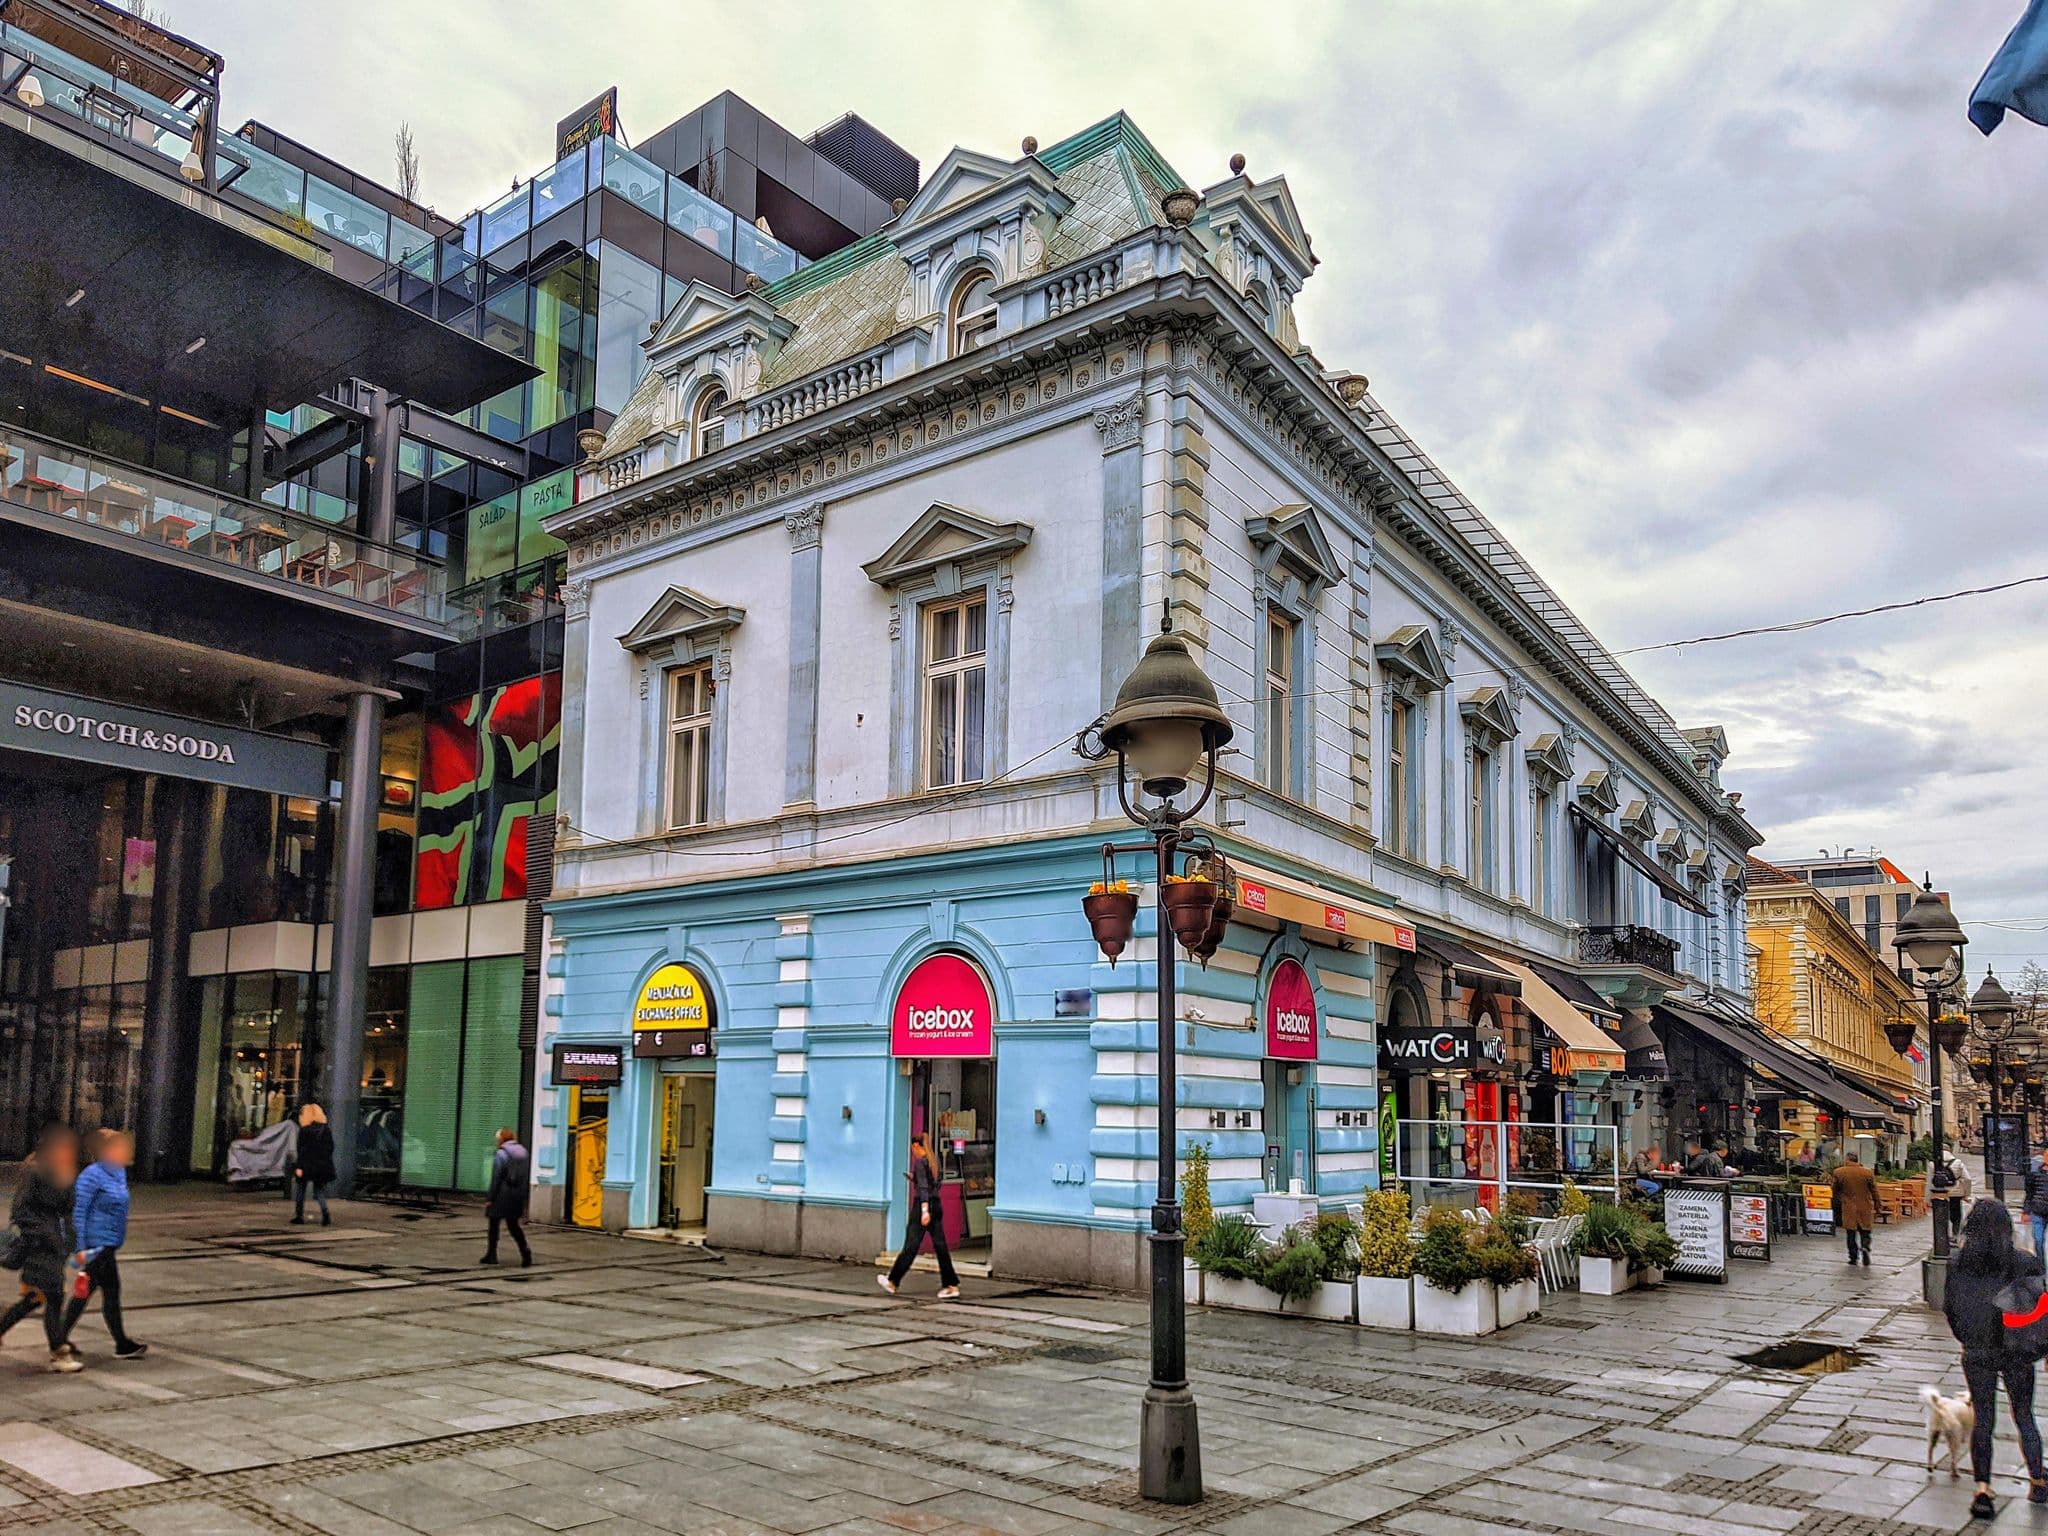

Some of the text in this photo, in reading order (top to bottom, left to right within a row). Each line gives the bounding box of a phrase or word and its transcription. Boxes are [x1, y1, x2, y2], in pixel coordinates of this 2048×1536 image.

[533, 482, 563, 506] PASTA
[479, 507, 506, 528] SALAD
[14, 705, 236, 764] SCOTCH&SODA
[638, 1005, 702, 1021] EXCHANGE OFFICE
[909, 1005, 974, 1030] icebox
[1276, 1007, 1310, 1035] icebox
[1385, 1032, 1469, 1063] WATCH
[1482, 1036, 1507, 1065] WATCH
[1551, 1047, 1572, 1077] BOX
[1678, 1212, 1710, 1220] BATERIJA
[1680, 1224, 1708, 1232] ZAMENA
[1681, 1252, 1708, 1260] SATOVA
[1682, 1244, 1706, 1252] SERVIS
